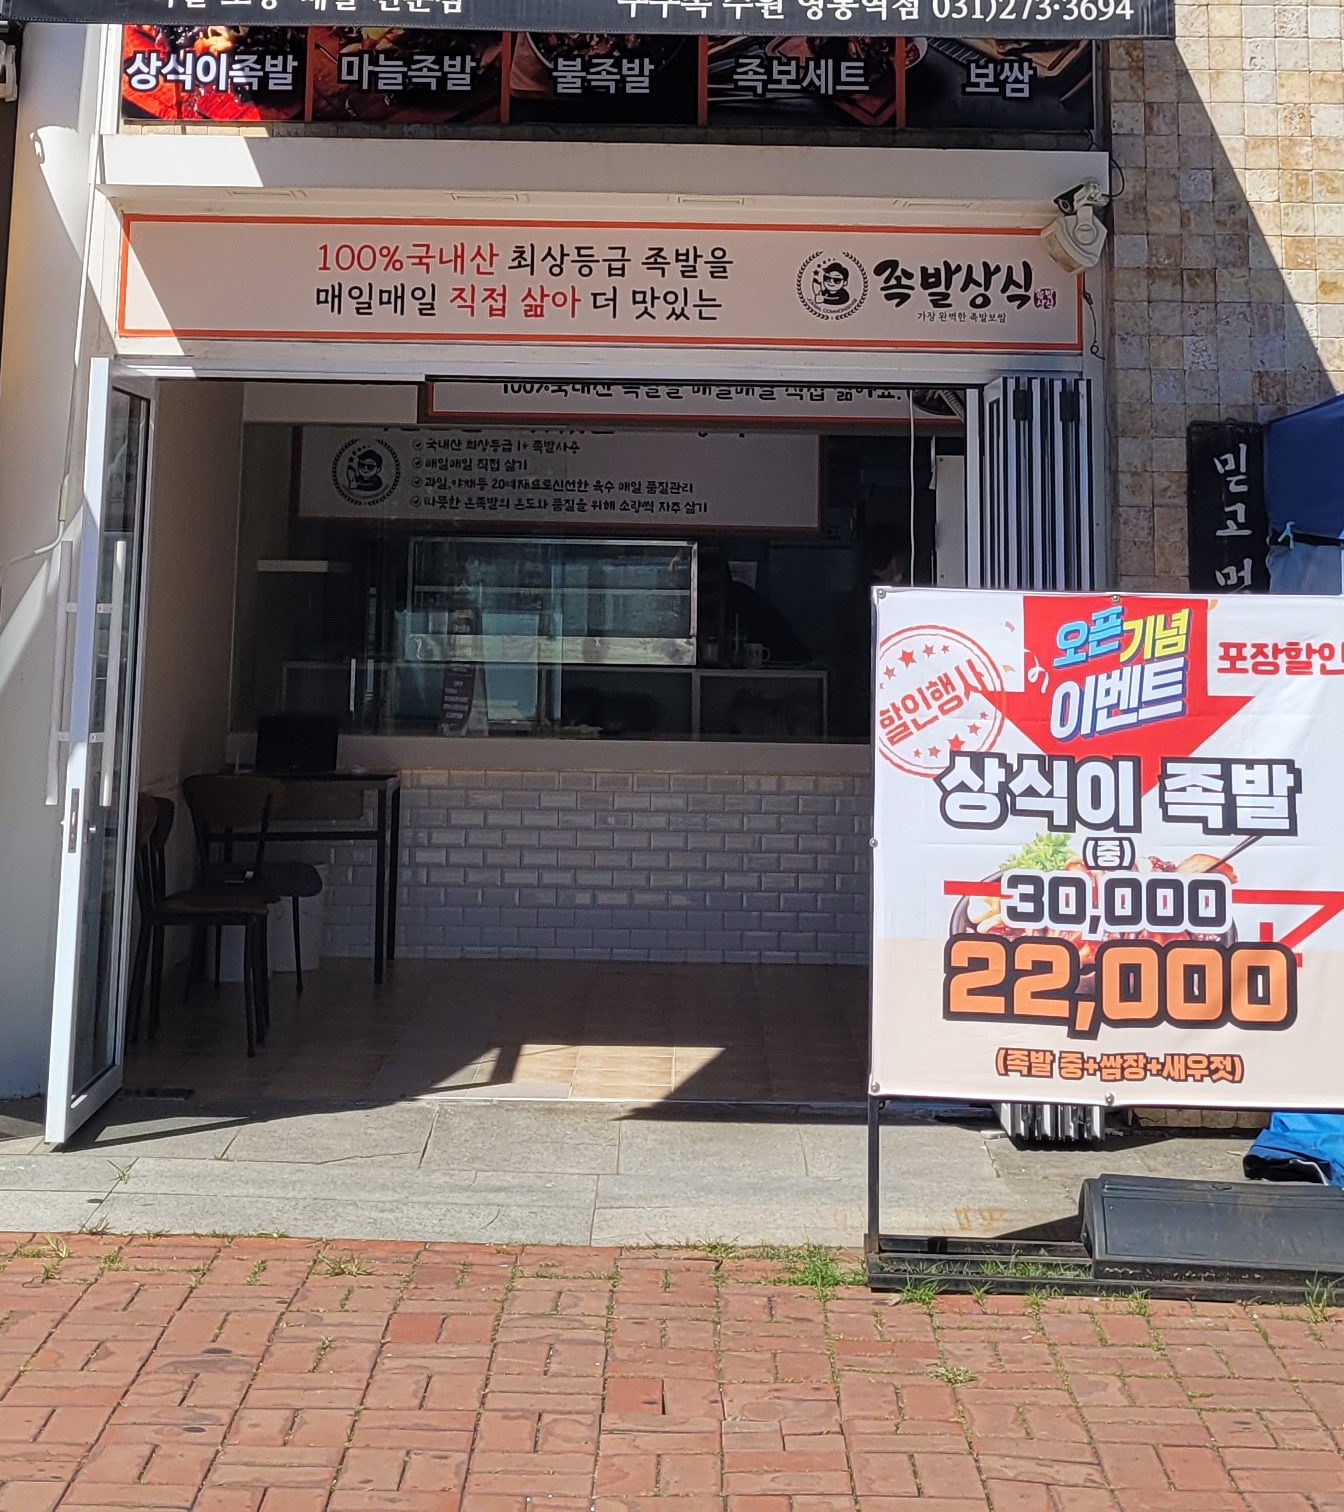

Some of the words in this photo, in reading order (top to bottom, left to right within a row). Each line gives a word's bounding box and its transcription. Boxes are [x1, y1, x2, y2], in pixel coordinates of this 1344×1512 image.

[125, 52, 297, 92] 상식이족발
[338, 53, 477, 92] 마늘족발
[551, 56, 655, 95] 불족발
[733, 57, 869, 95] 족보세트
[965, 59, 1035, 100] 보쌈
[317, 241, 500, 276] 100%국내산
[507, 242, 632, 278] 최상등급
[640, 245, 734, 279] 족발을
[315, 282, 437, 317] 매일매일
[449, 284, 508, 319] 직접
[521, 285, 581, 319] 삶아
[590, 287, 618, 320] 더
[631, 287, 723, 321] 맛있는
[873, 259, 1033, 310] 족발상식
[917, 311, 935, 323] 가장
[938, 311, 967, 323] 완벽한
[969, 311, 1007, 324] 족발보쌈
[425, 439, 462, 452] 국내산
[466, 440, 513, 452] 최상등급
[532, 440, 580, 454] 족발사용
[425, 458, 473, 471] 매일매일
[477, 458, 500, 471] 직접
[504, 459, 527, 471] 삶기
[424, 496, 461, 509] 따뜻한
[464, 497, 510, 510] 온족발의
[514, 498, 548, 510] 온도와
[551, 499, 587, 512] 품질을
[591, 499, 615, 512] 위해
[619, 500, 654, 513] 소량씩
[658, 501, 681, 513] 자주
[684, 501, 707, 514] 삶기
[593, 480, 614, 494] 육수
[619, 481, 642, 494] 매일
[645, 481, 694, 494] 품질관리
[1053, 605, 1192, 669] 오픈기념
[879, 658, 988, 747] 할인행사
[1050, 657, 1187, 743] 이벤트
[937, 754, 1144, 833] 상식이
[1159, 757, 1301, 835] 족발
[1083, 837, 1135, 870] (중)
[1005, 873, 1228, 934] 30,000
[943, 938, 1299, 1040] 22,000
[995, 1047, 1055, 1078] (족발
[1058, 1050, 1244, 1083] 중+쌈장+새우젓)
